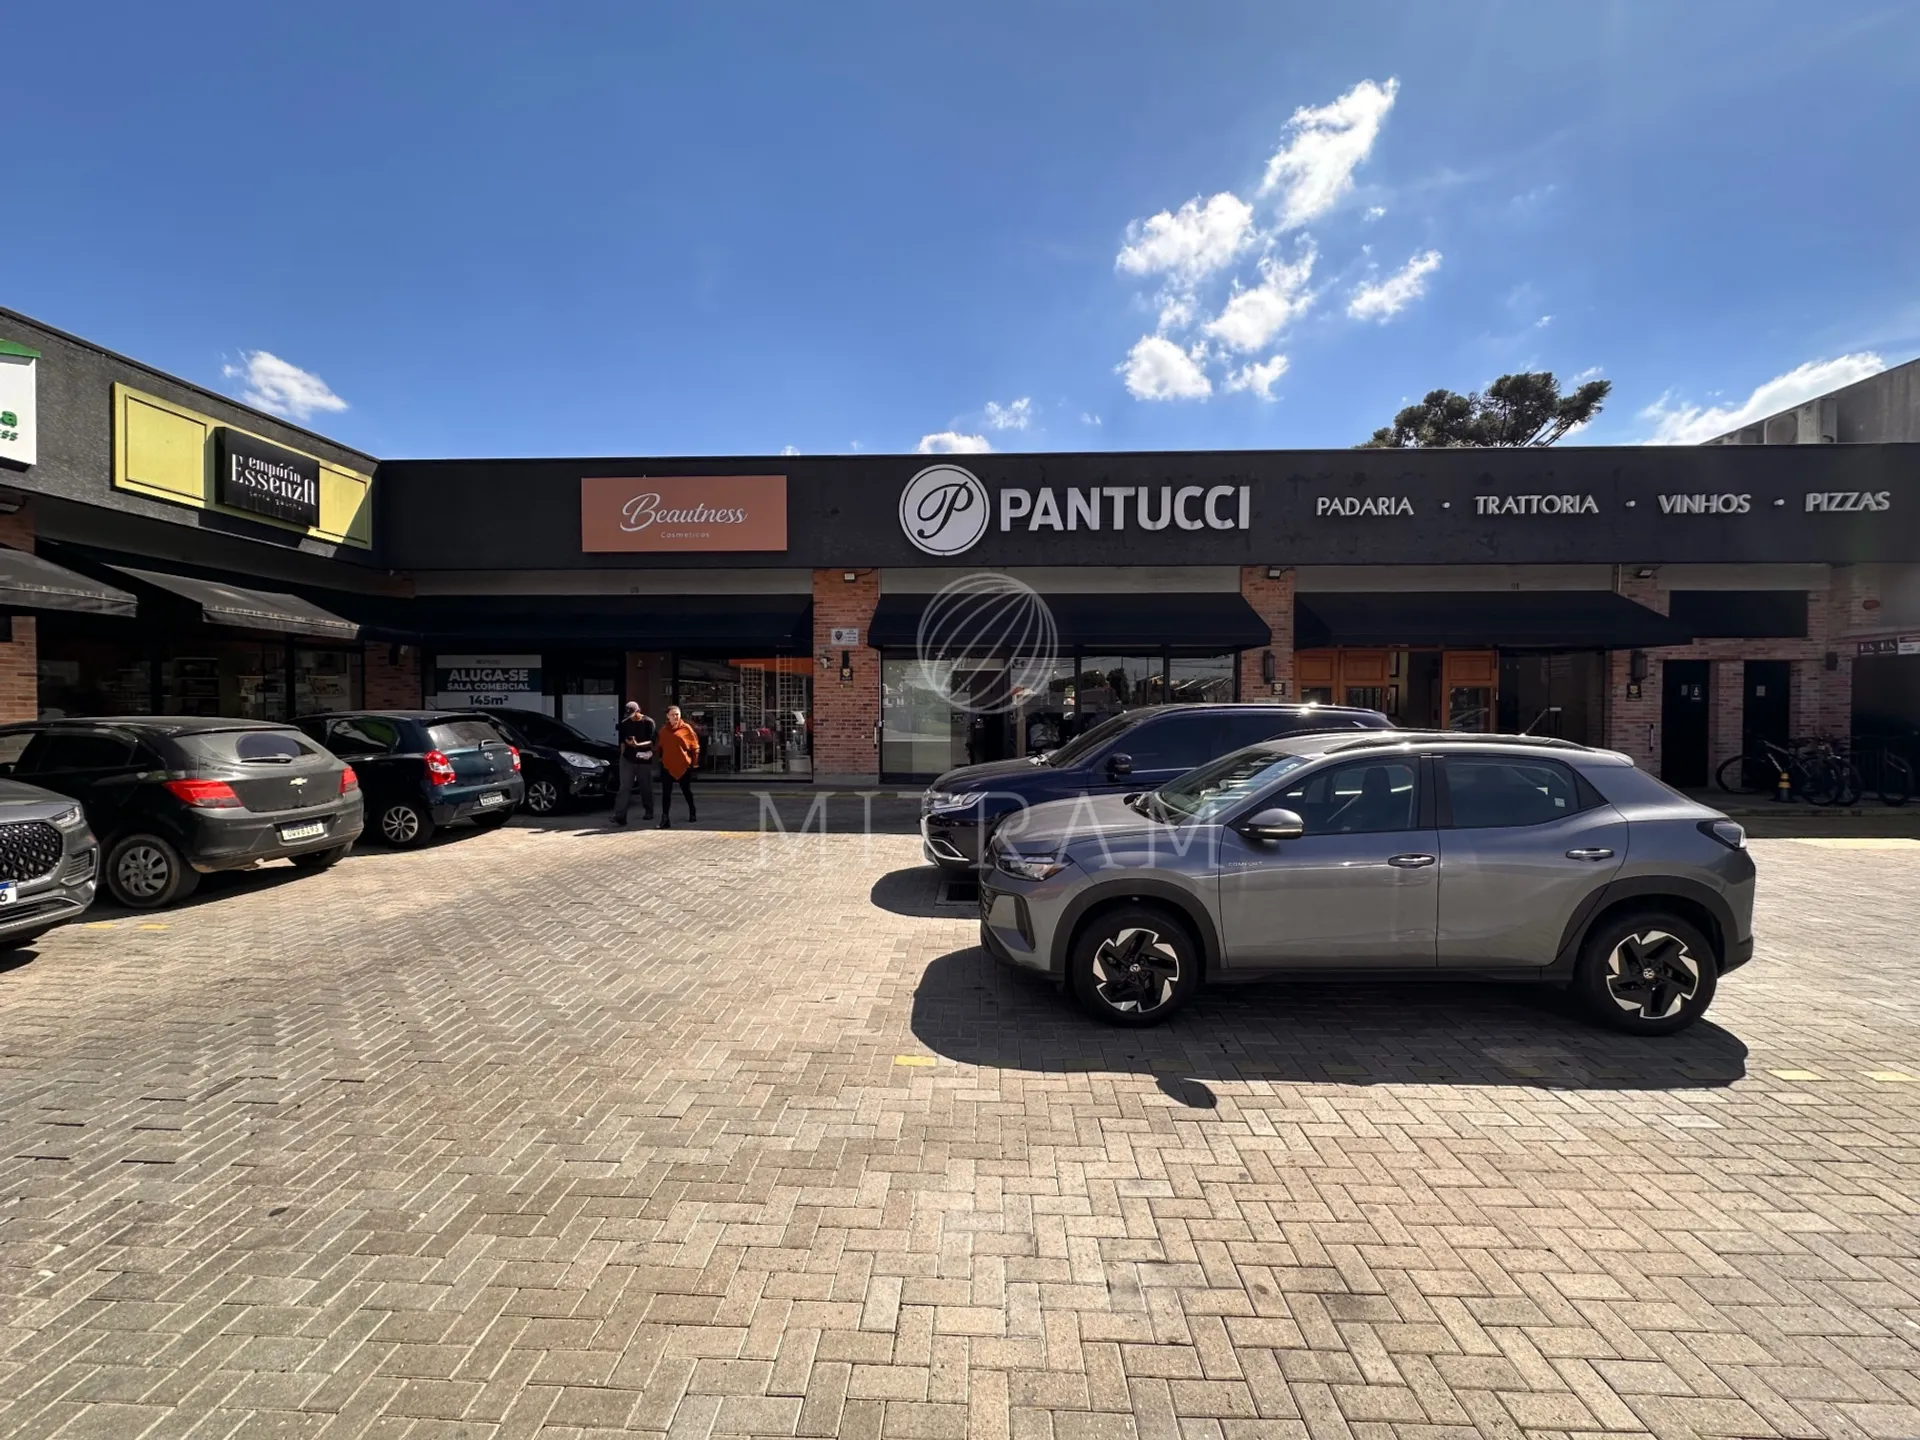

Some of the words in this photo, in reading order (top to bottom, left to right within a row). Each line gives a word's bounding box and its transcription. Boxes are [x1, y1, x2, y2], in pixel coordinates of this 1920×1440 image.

[619, 492, 749, 532] Beautness
[1000, 486, 1250, 532] PANTUCCI
[1316, 496, 1415, 516] PADARIA
[1473, 494, 1598, 515] TRATTORIA
[1657, 494, 1752, 514] VINHOS
[1804, 491, 1891, 512] PIZZAS
[446, 682, 472, 691] SALA
[474, 682, 531, 691] COMERCIAL
[448, 669, 529, 682] ALUGA-SE
